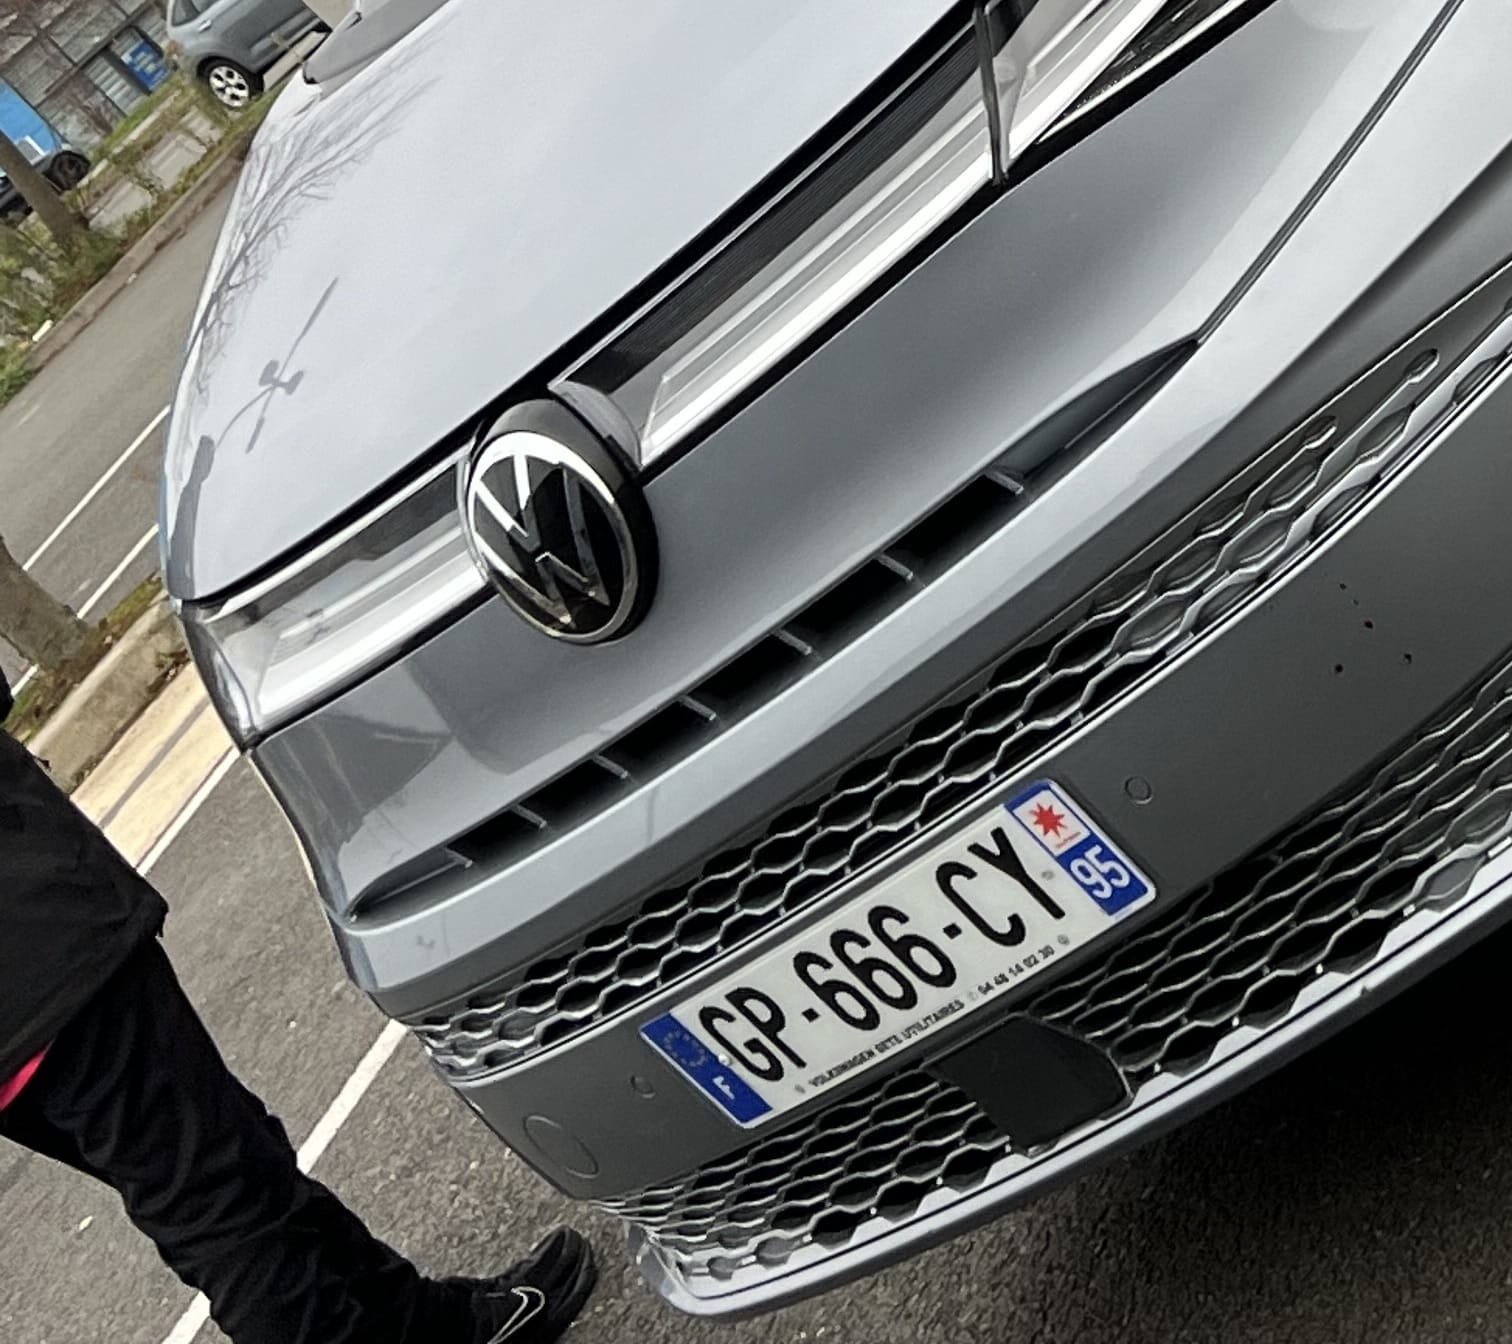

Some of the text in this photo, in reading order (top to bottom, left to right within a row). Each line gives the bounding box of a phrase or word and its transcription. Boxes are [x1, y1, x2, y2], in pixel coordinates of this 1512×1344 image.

[469, 432, 635, 642] VW
[1070, 844, 1131, 900] 95
[699, 826, 1066, 1081] GP-666-CY
[713, 1075, 736, 1101] F
